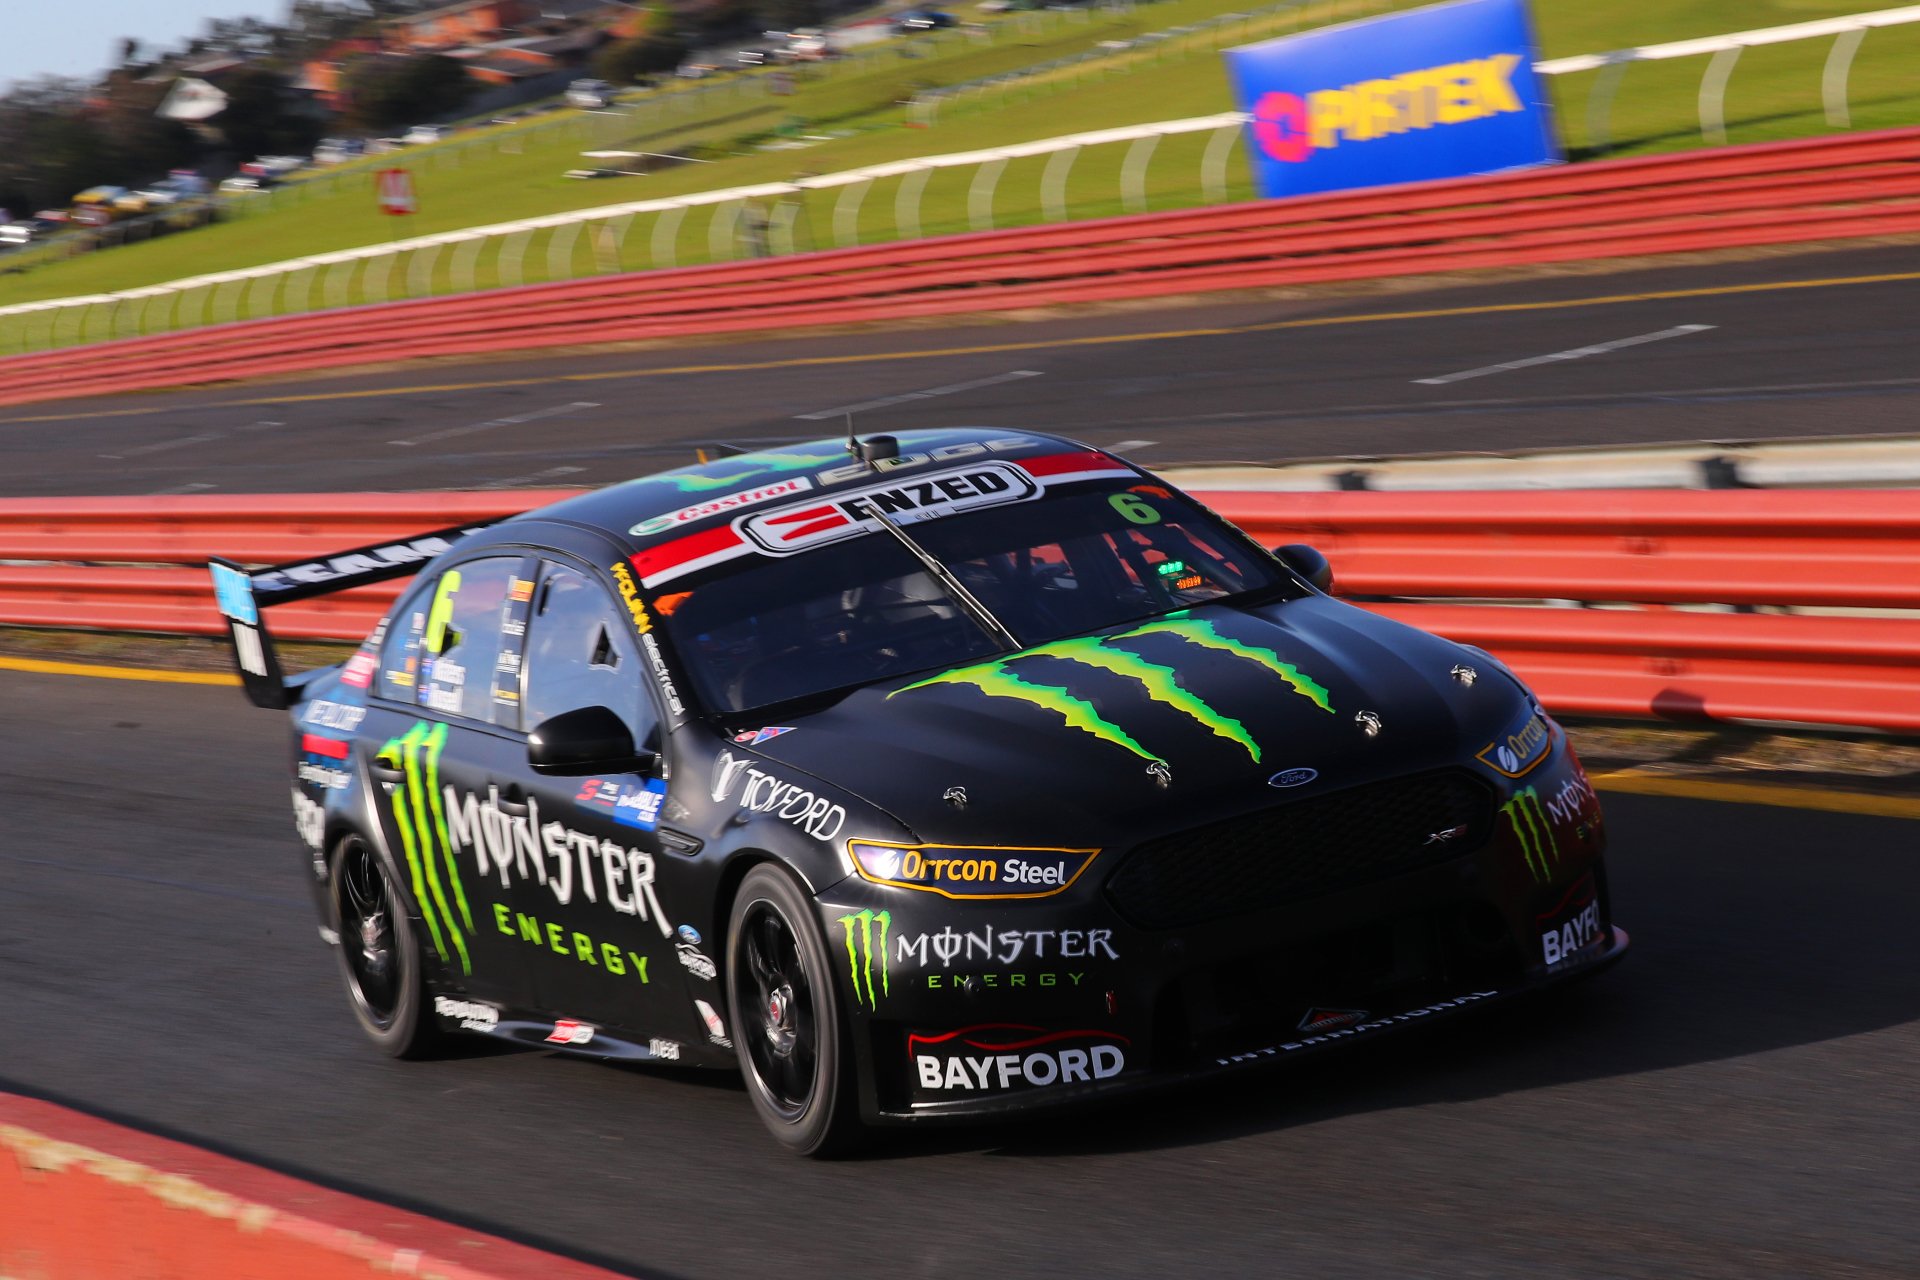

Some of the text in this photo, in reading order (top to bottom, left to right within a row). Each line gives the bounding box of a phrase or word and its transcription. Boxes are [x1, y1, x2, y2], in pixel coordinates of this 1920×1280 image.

[677, 480, 803, 522] Castrol
[838, 471, 1010, 522] ENZED
[1107, 493, 1161, 525] 6
[740, 768, 846, 841] TICKFORD
[901, 850, 1066, 885] Orrcon Steel
[492, 902, 650, 984] ENERGY
[1541, 896, 1600, 965] BAYFO
[927, 972, 1085, 988] ENERGY
[1216, 990, 1499, 1066] INTERNATIONAL
[916, 1044, 1125, 1090] BAYFORD
